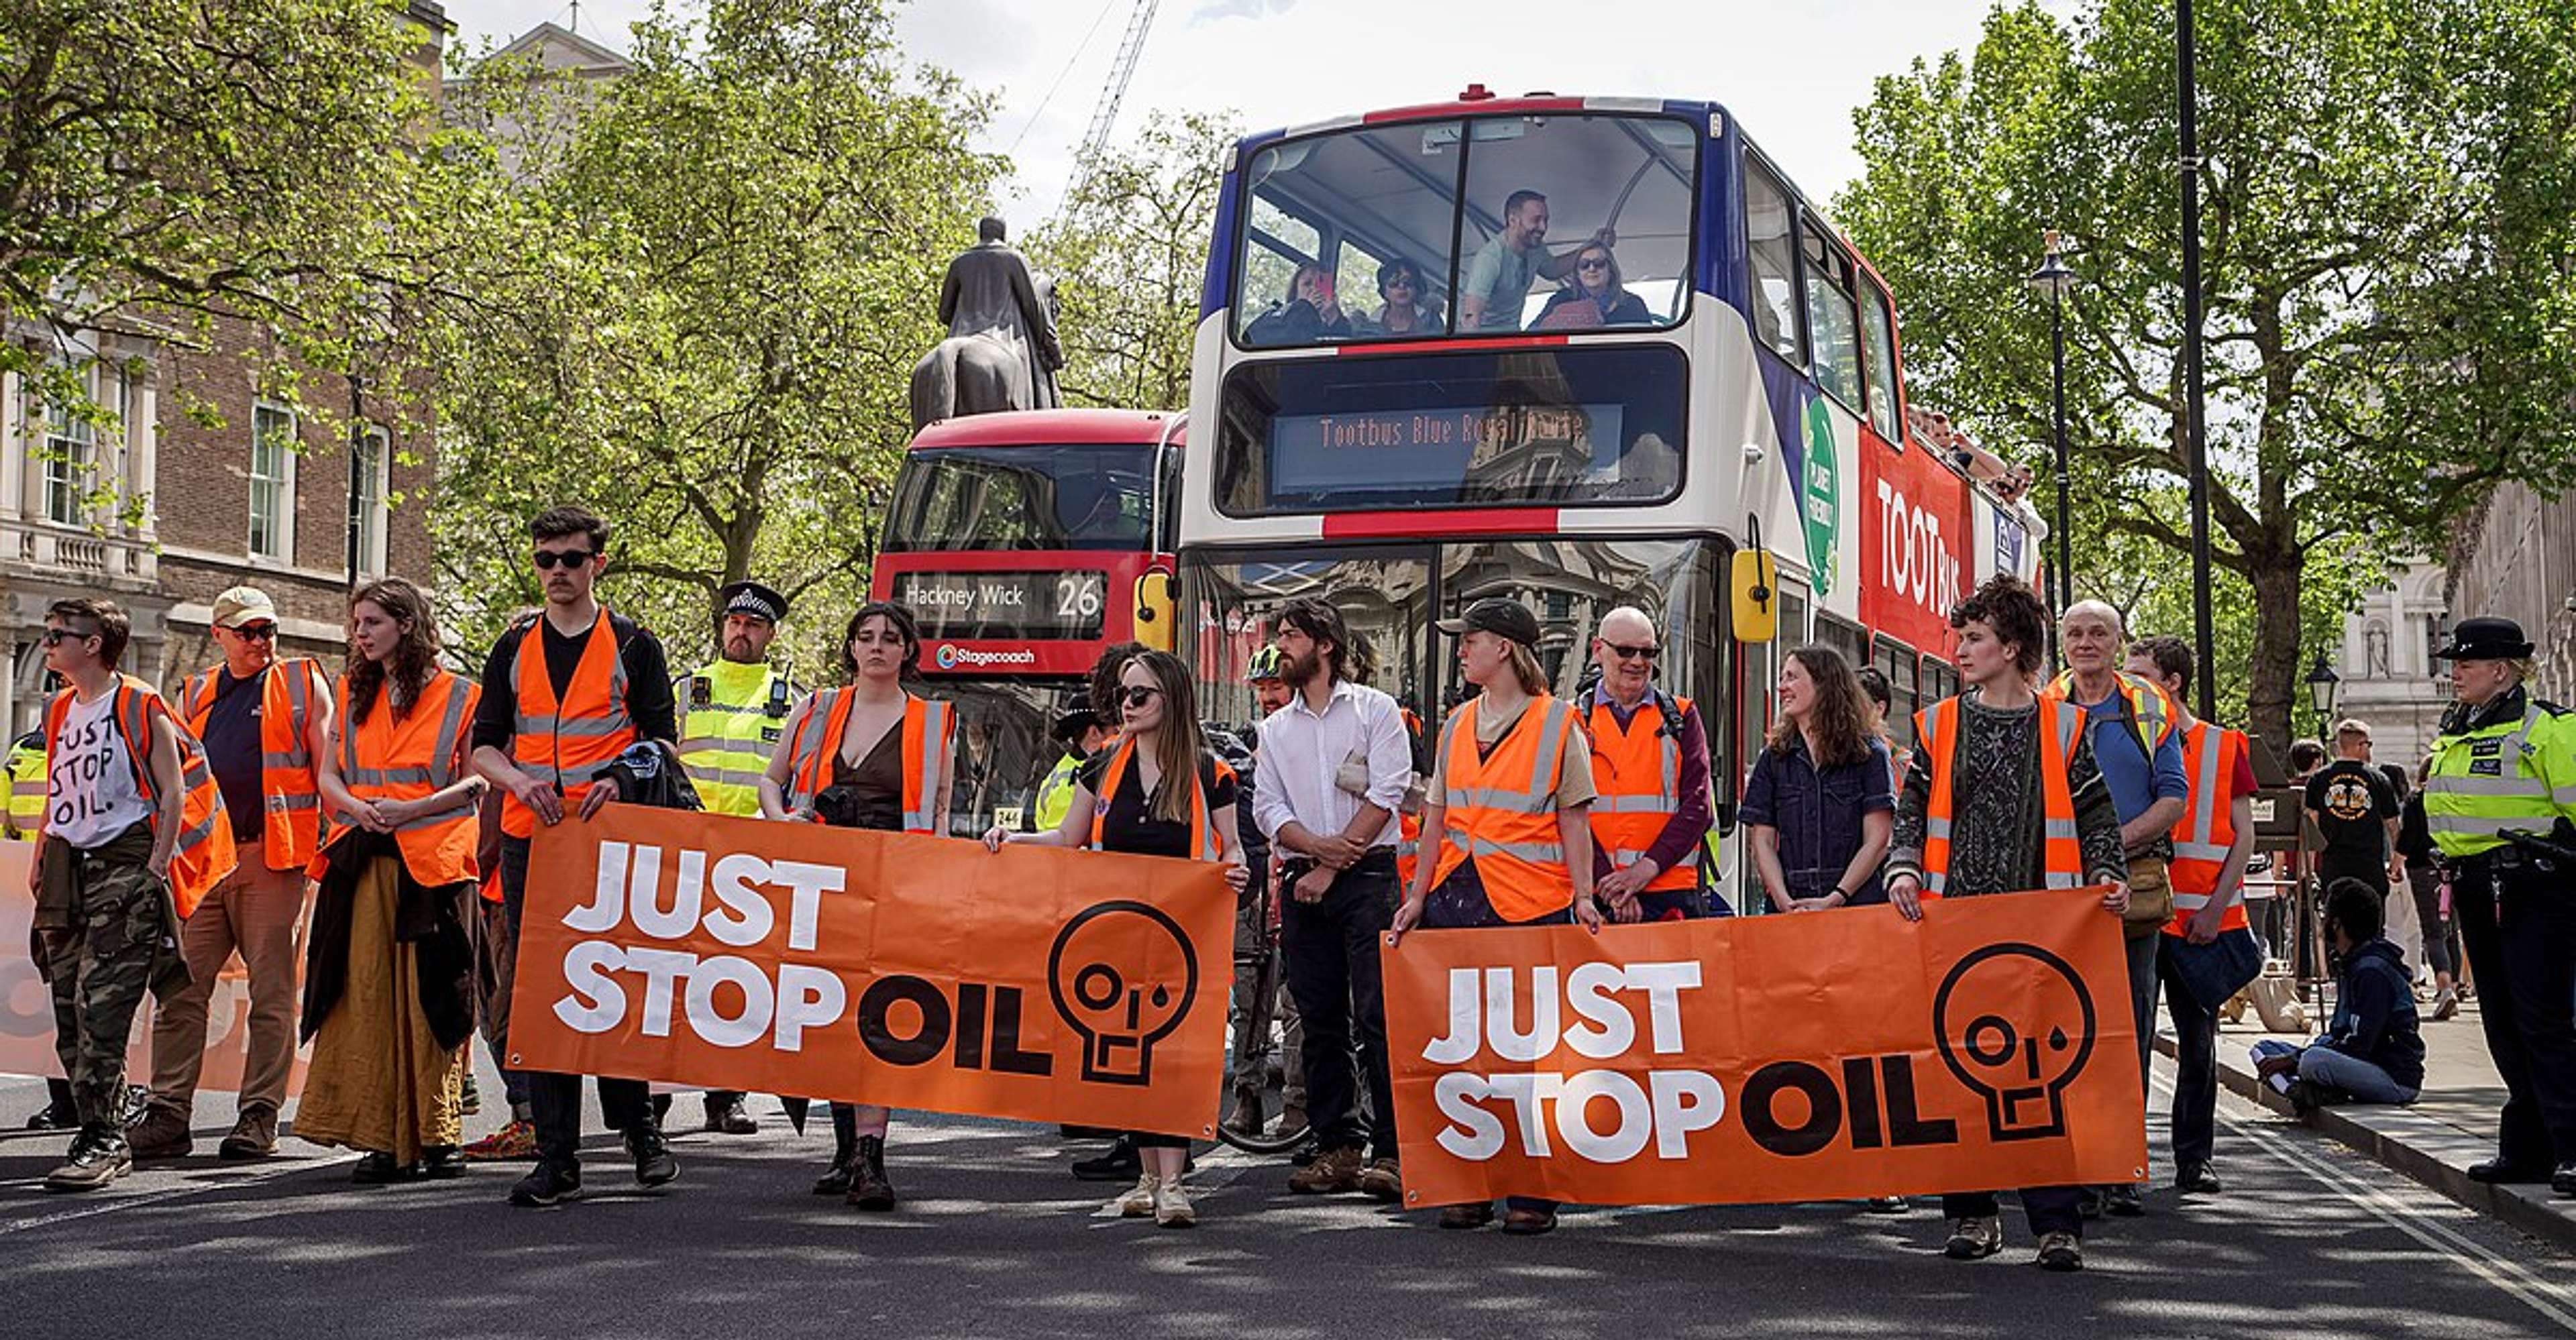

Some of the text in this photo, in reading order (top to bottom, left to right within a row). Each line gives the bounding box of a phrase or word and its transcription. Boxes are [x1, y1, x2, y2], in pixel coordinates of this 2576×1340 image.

[1320, 414, 1401, 447] Tootbus
[1413, 416, 1452, 444] Blue
[1462, 412, 1515, 444] Royal
[906, 579, 1099, 616] Hackney Wick 26
[957, 649, 1034, 666] Stagecoach
[50, 747, 113, 797] STOP
[54, 790, 114, 826] OIL.
[561, 840, 846, 951] JUST
[553, 940, 1053, 1076] STOP OIL
[1421, 961, 1703, 1064] JUST
[1434, 1054, 1959, 1164] STOP OIL
